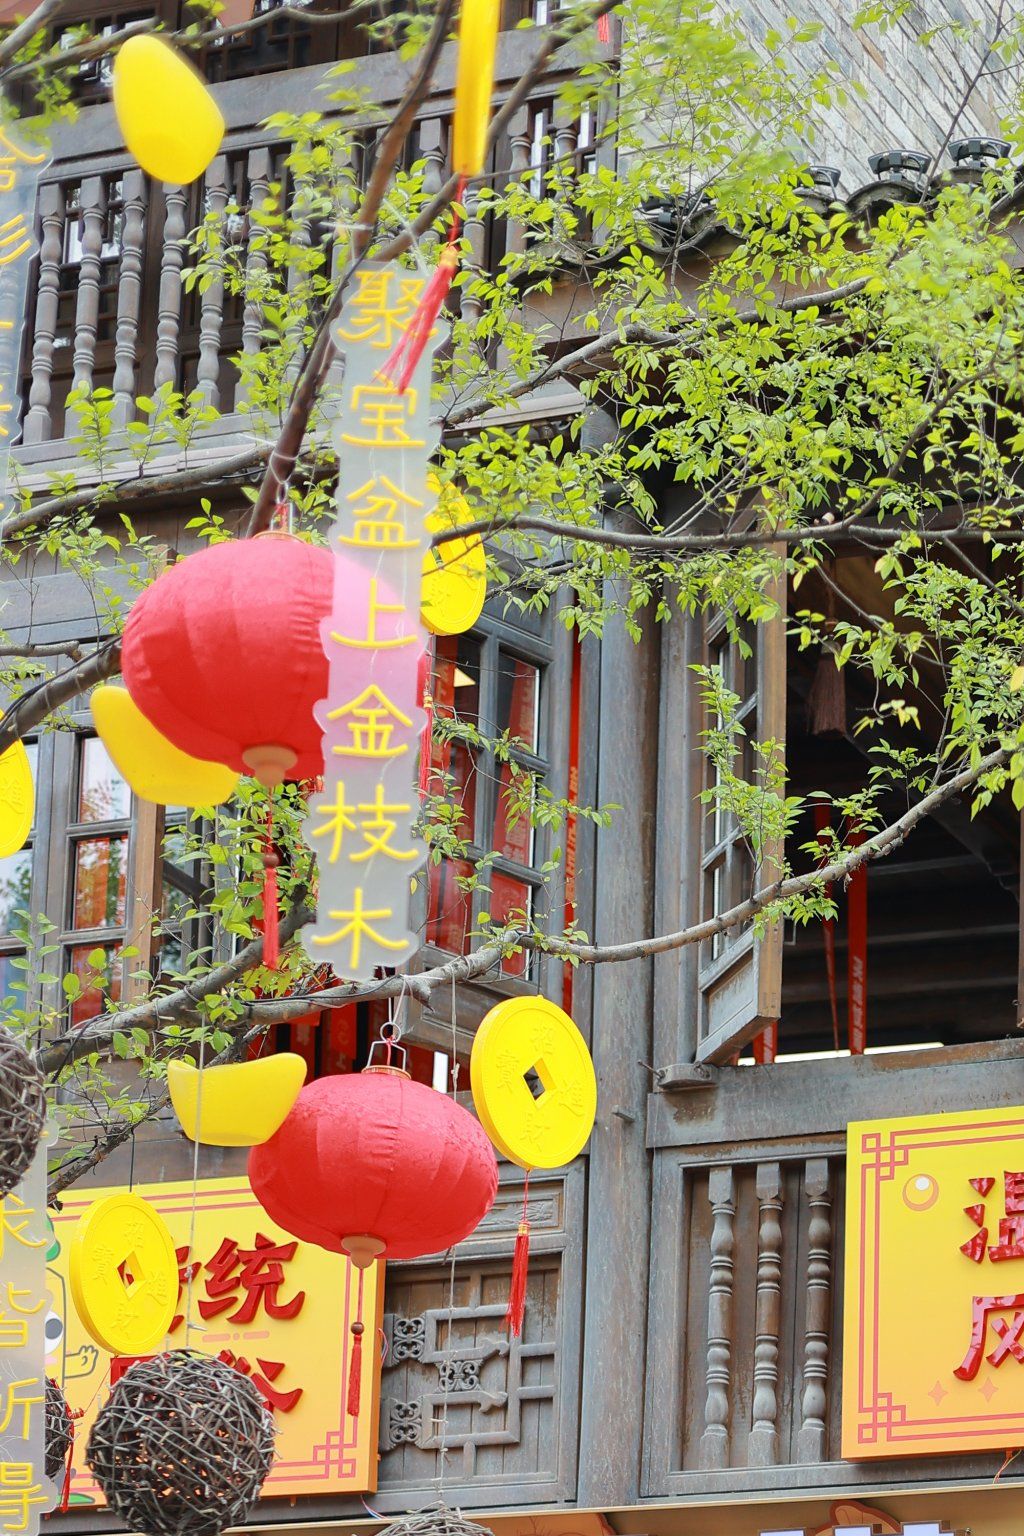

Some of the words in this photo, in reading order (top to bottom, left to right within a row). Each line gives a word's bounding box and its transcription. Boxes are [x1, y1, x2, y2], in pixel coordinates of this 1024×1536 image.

[311, 270, 438, 970] 聚宝盆上金枝木
[168, 1232, 305, 1334] 统
